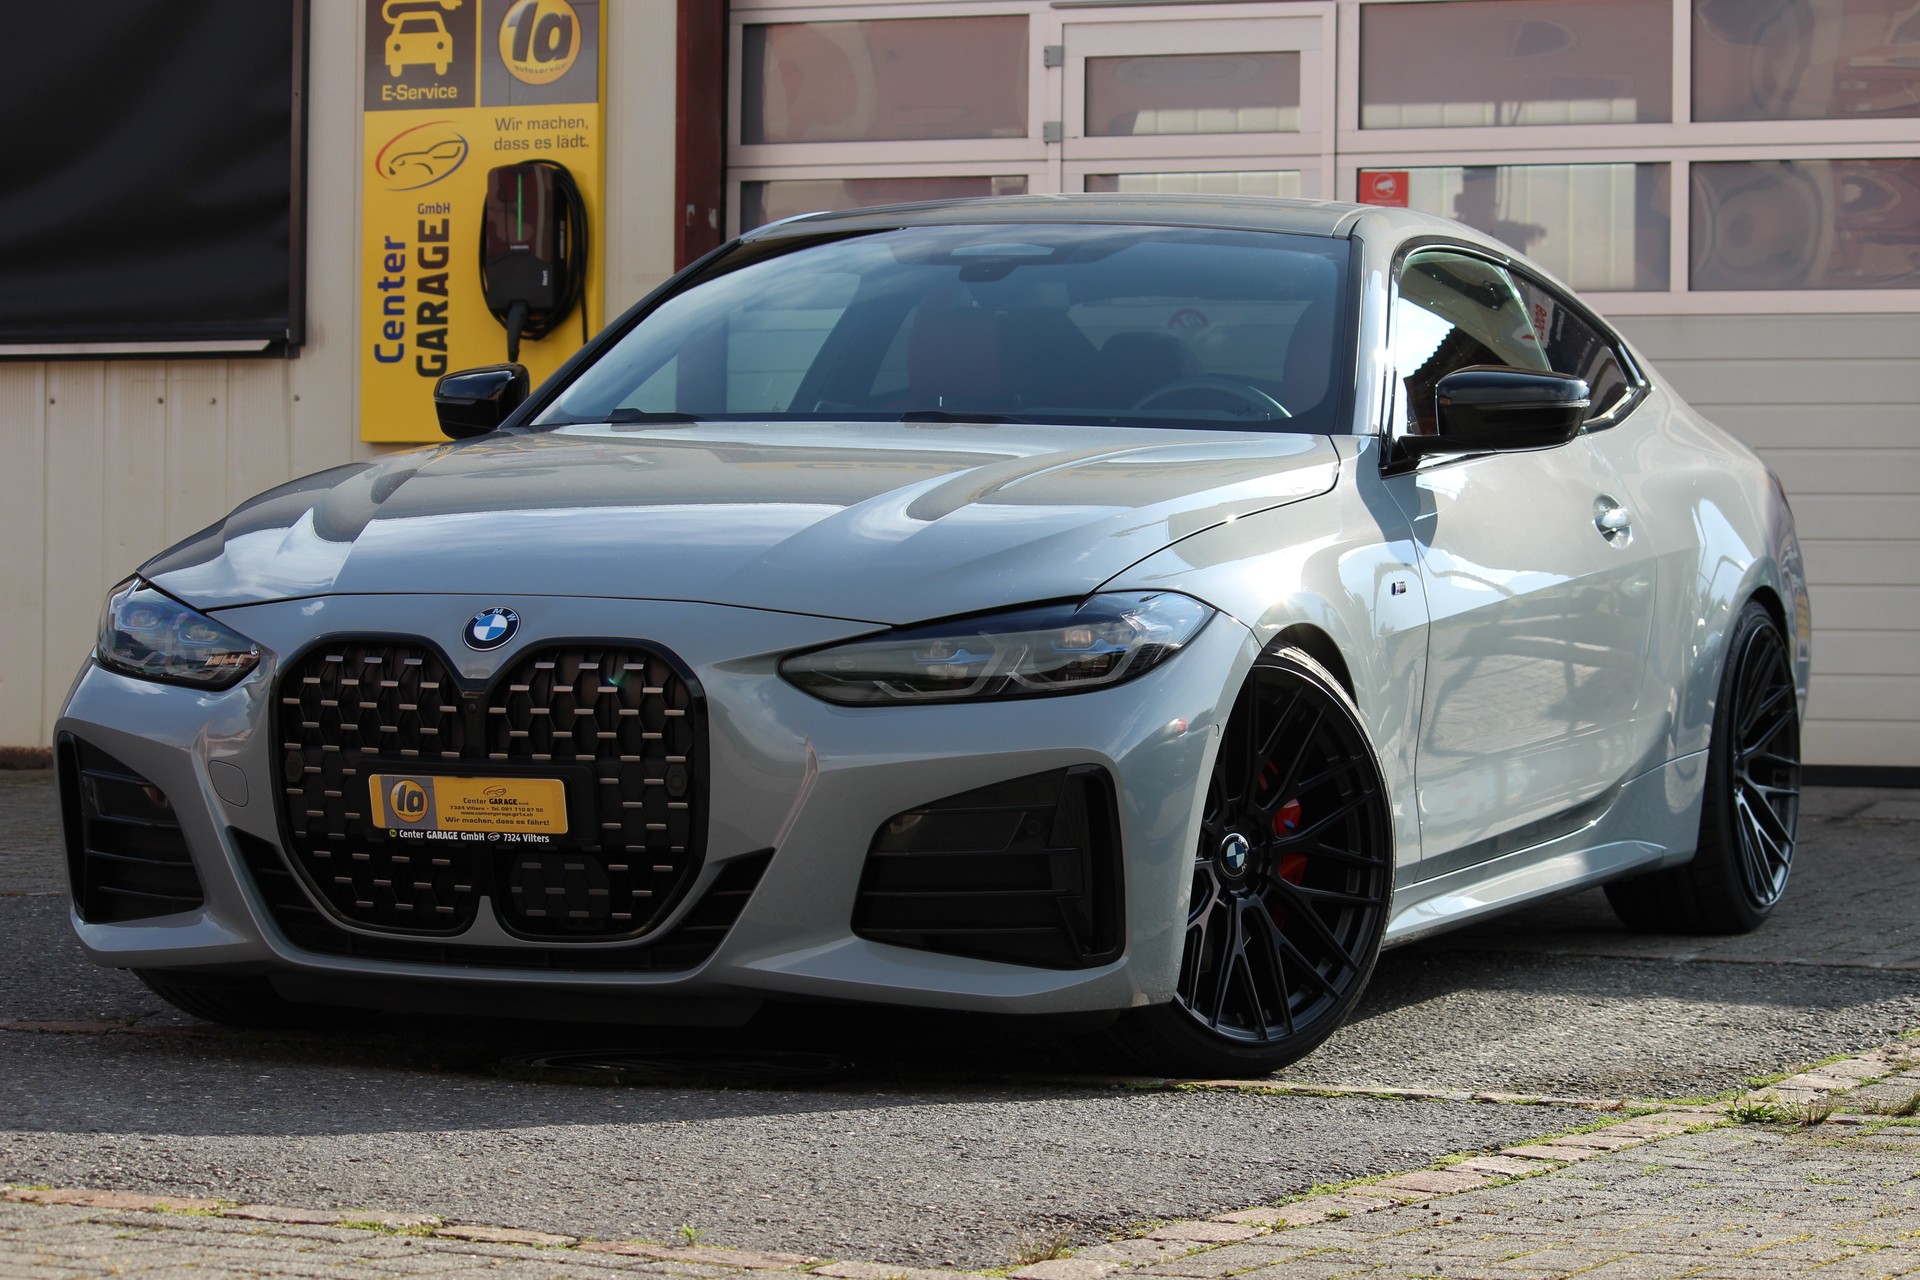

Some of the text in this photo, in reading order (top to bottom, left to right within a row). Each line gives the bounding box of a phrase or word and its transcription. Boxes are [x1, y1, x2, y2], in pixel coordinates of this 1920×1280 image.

[507, 0, 573, 63] 1a
[382, 83, 457, 101] E-Service
[495, 116, 589, 131] Wir machen,
[494, 134, 589, 151] dass es lädt.
[416, 203, 450, 378] GARAGE GmbH
[374, 235, 406, 364] Center
[476, 609, 517, 621] BMW
[463, 797, 487, 805] Center
[489, 798, 518, 806] GARAGE
[462, 817, 495, 825] machen,
[527, 819, 550, 827] fährt!
[399, 829, 424, 839] Center
[426, 830, 458, 840] GARAGE
[460, 832, 485, 841] GmbH
[503, 833, 521, 843] 7324
[522, 833, 550, 843] Vilters
